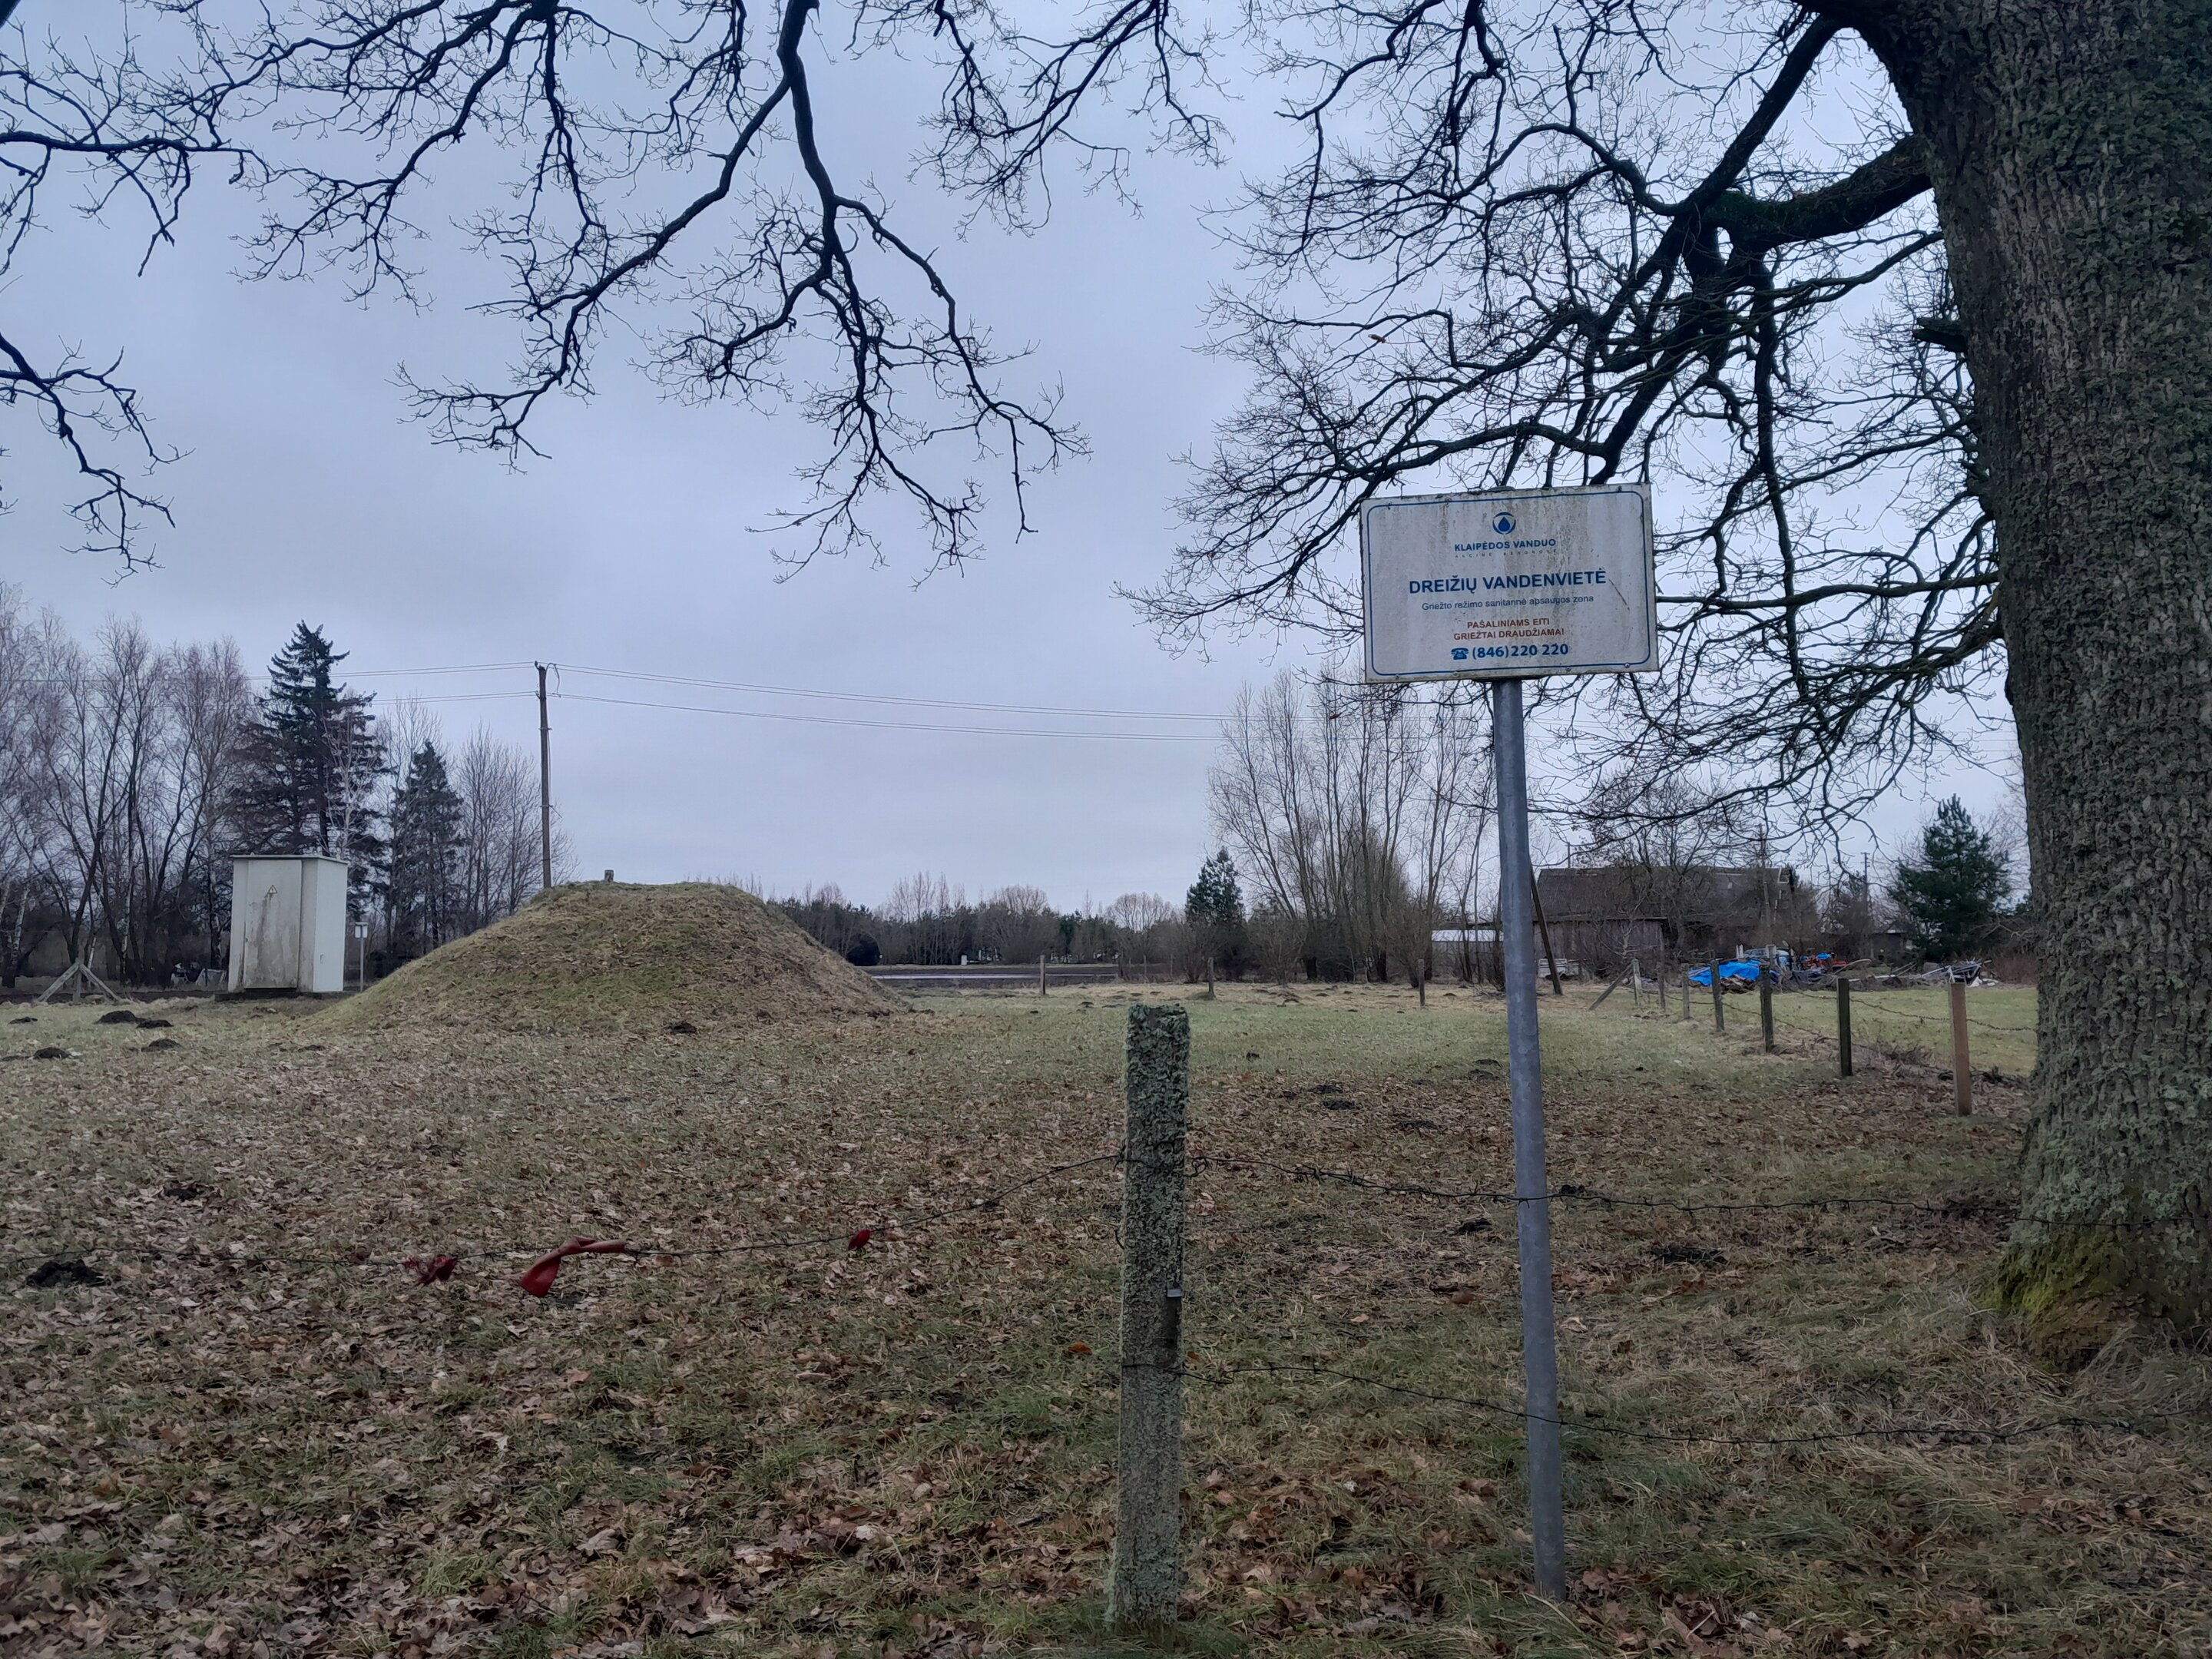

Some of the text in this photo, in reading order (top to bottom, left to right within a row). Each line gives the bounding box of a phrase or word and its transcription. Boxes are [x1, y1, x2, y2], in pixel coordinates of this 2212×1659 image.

[1455, 538, 1556, 551] KLAIPĖDOS VANDUO
[1409, 568, 1607, 594] DREIŽIŲ VANDENVIETĖ
[1422, 602, 1452, 611] Griežto
[1455, 600, 1483, 608] režimo
[1529, 597, 1571, 606] apsaugos
[1467, 619, 1530, 628] PAŠALINIAMS
[1454, 631, 1496, 641] GRIEŽTAI
[1541, 643, 1569, 655] 220
